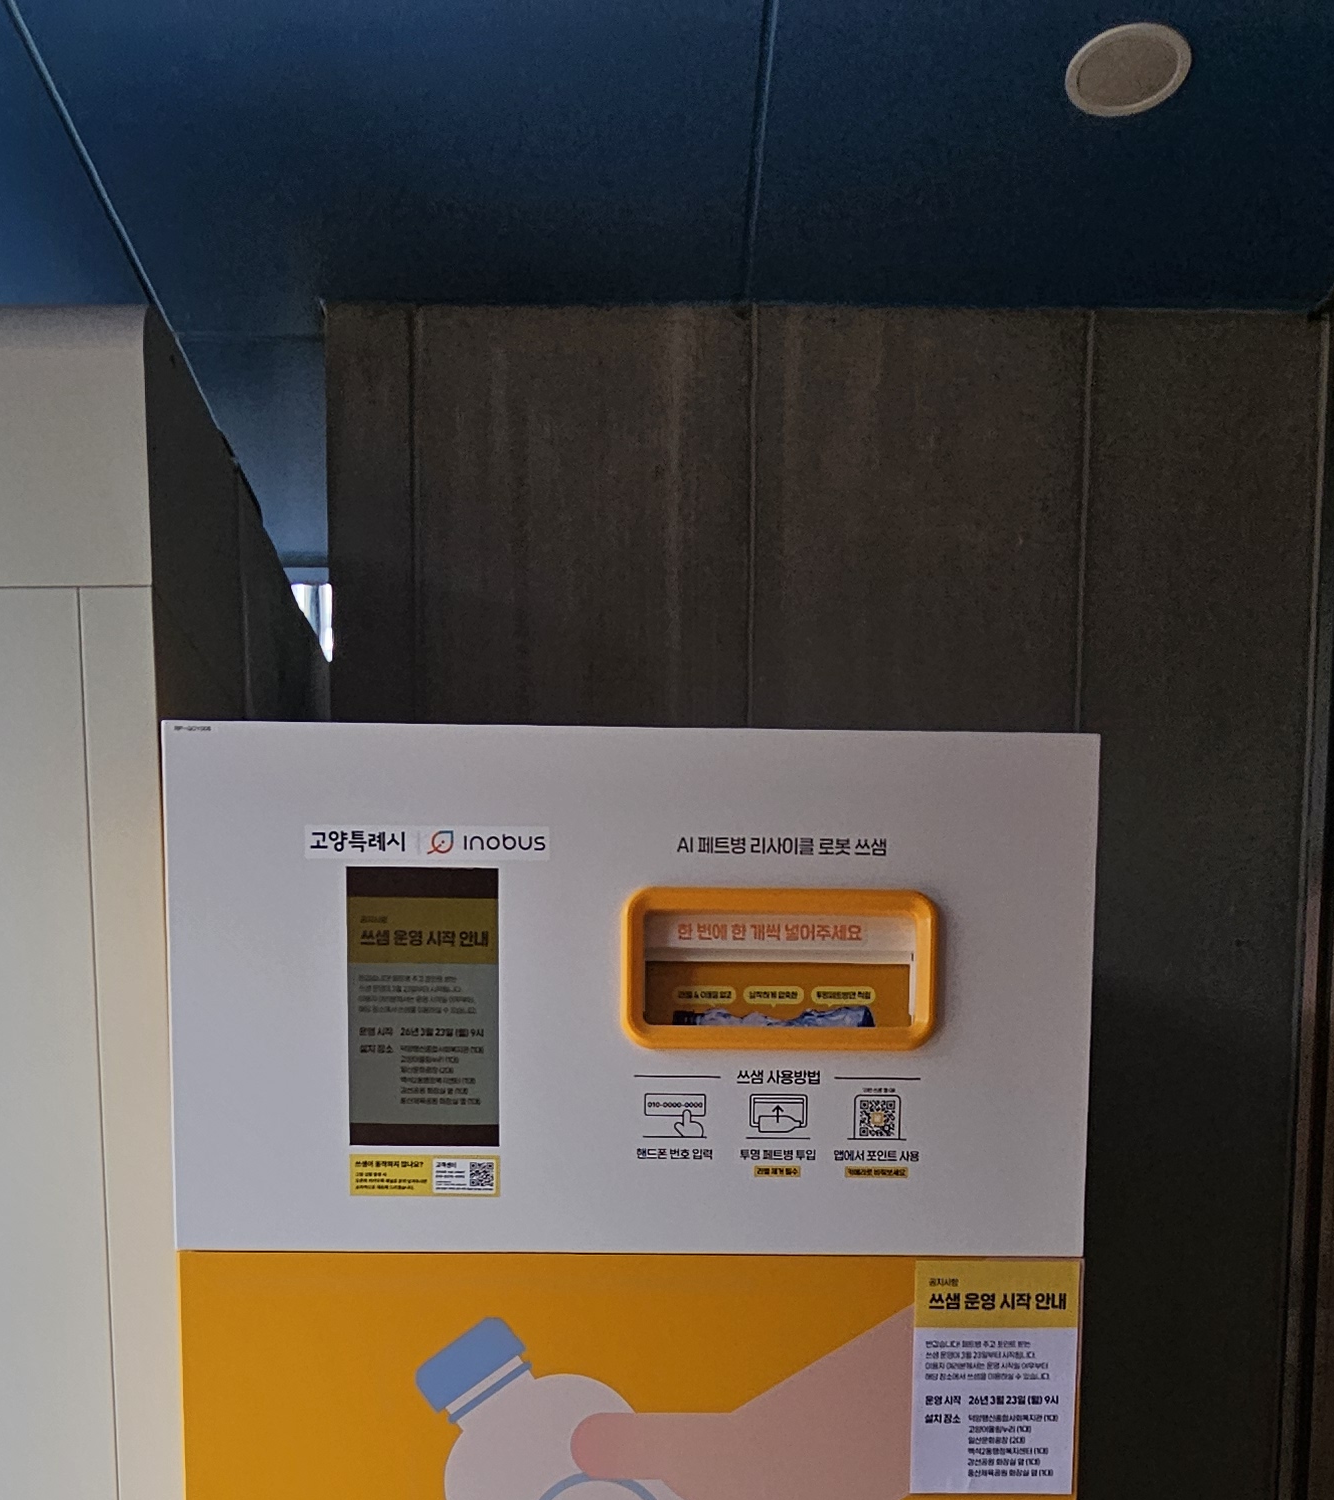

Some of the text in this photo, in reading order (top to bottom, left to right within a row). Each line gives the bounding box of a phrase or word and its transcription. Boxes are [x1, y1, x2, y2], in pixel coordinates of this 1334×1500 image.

[310, 831, 405, 853] 고양특례시
[463, 834, 546, 851] inobus
[677, 837, 887, 856] AI 페트병 리사이클 로봇 쓰샘
[360, 930, 489, 947] 쓰샘 운영 시작 안내
[678, 923, 693, 941] 한
[697, 923, 728, 941] 번에
[731, 923, 747, 941] 한
[750, 923, 782, 941] 개씩
[736, 1069, 821, 1086] 쓰샘 사용방법
[647, 1101, 704, 1109] 010-0000-0000
[636, 1147, 714, 1161] 핸드폰 번호 입력
[739, 1148, 817, 1162] 투명 페트병 투입
[834, 1149, 920, 1163] 앱에서 포인트 사용
[929, 1293, 1067, 1310] 쓰샘 운영 시작 안내
[925, 1396, 1059, 1405] 운영 시작 26년 3월 23일 (월) 9시
